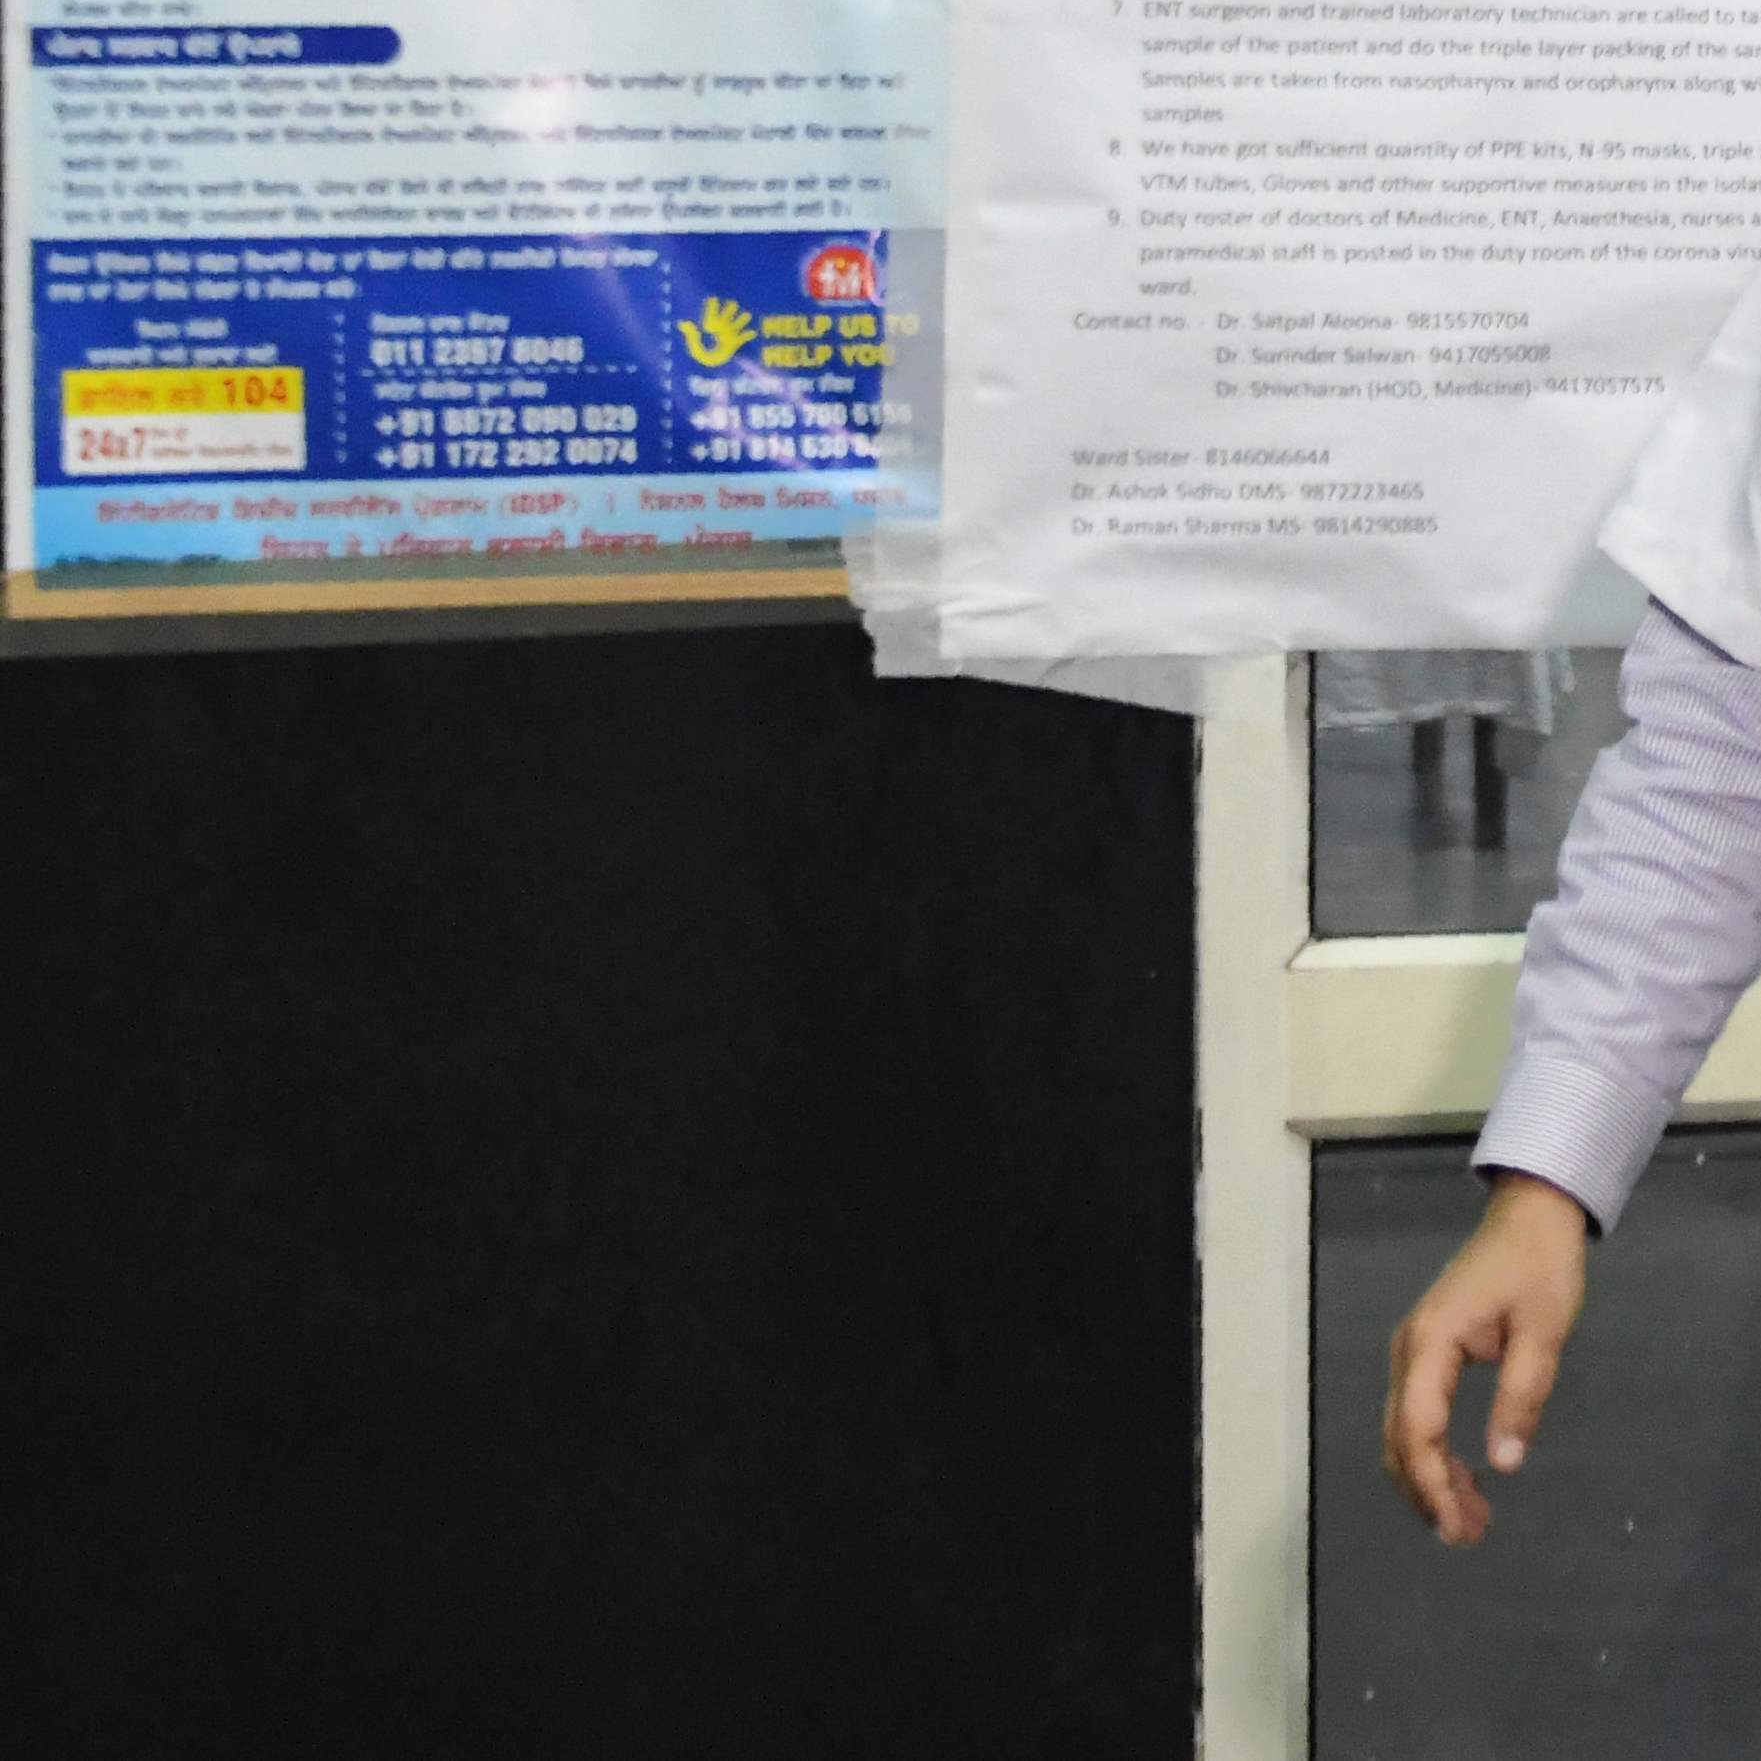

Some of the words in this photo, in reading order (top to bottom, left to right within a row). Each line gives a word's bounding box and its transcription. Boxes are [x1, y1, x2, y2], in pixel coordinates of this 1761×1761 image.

[1188, 2, 1271, 22] surgeon
[1277, 1, 1316, 19] and
[1320, 1, 1395, 20] trained
[1399, 2, 1505, 26] laboratory
[1510, 4, 1611, 23] technician
[1617, 8, 1648, 23] are
[1652, 5, 1710, 24] called
[1714, 6, 1735, 24] to
[1141, 68, 1226, 91] Samples
[1231, 72, 1265, 88] are
[1269, 70, 1327, 88] taken
[1332, 70, 1383, 89] from
[1388, 71, 1516, 94] nasopharynx
[1522, 72, 1560, 90] and
[1564, 72, 1677, 95] oropharynx
[1683, 73, 1736, 95] along
[1138, 208, 1188, 230] Duty
[1193, 208, 1254, 226] roster
[1259, 208, 1283, 226] of
[1286, 208, 1364, 226] doctors
[1368, 208, 1391, 226] of
[1680, 212, 1745, 227] nurses
[762, 313, 832, 338] HELP
[838, 313, 876, 338] US
[1072, 310, 1153, 329] Contact
[762, 344, 832, 367] HELP
[223, 375, 288, 407] 104
[1070, 447, 1129, 465] Ward
